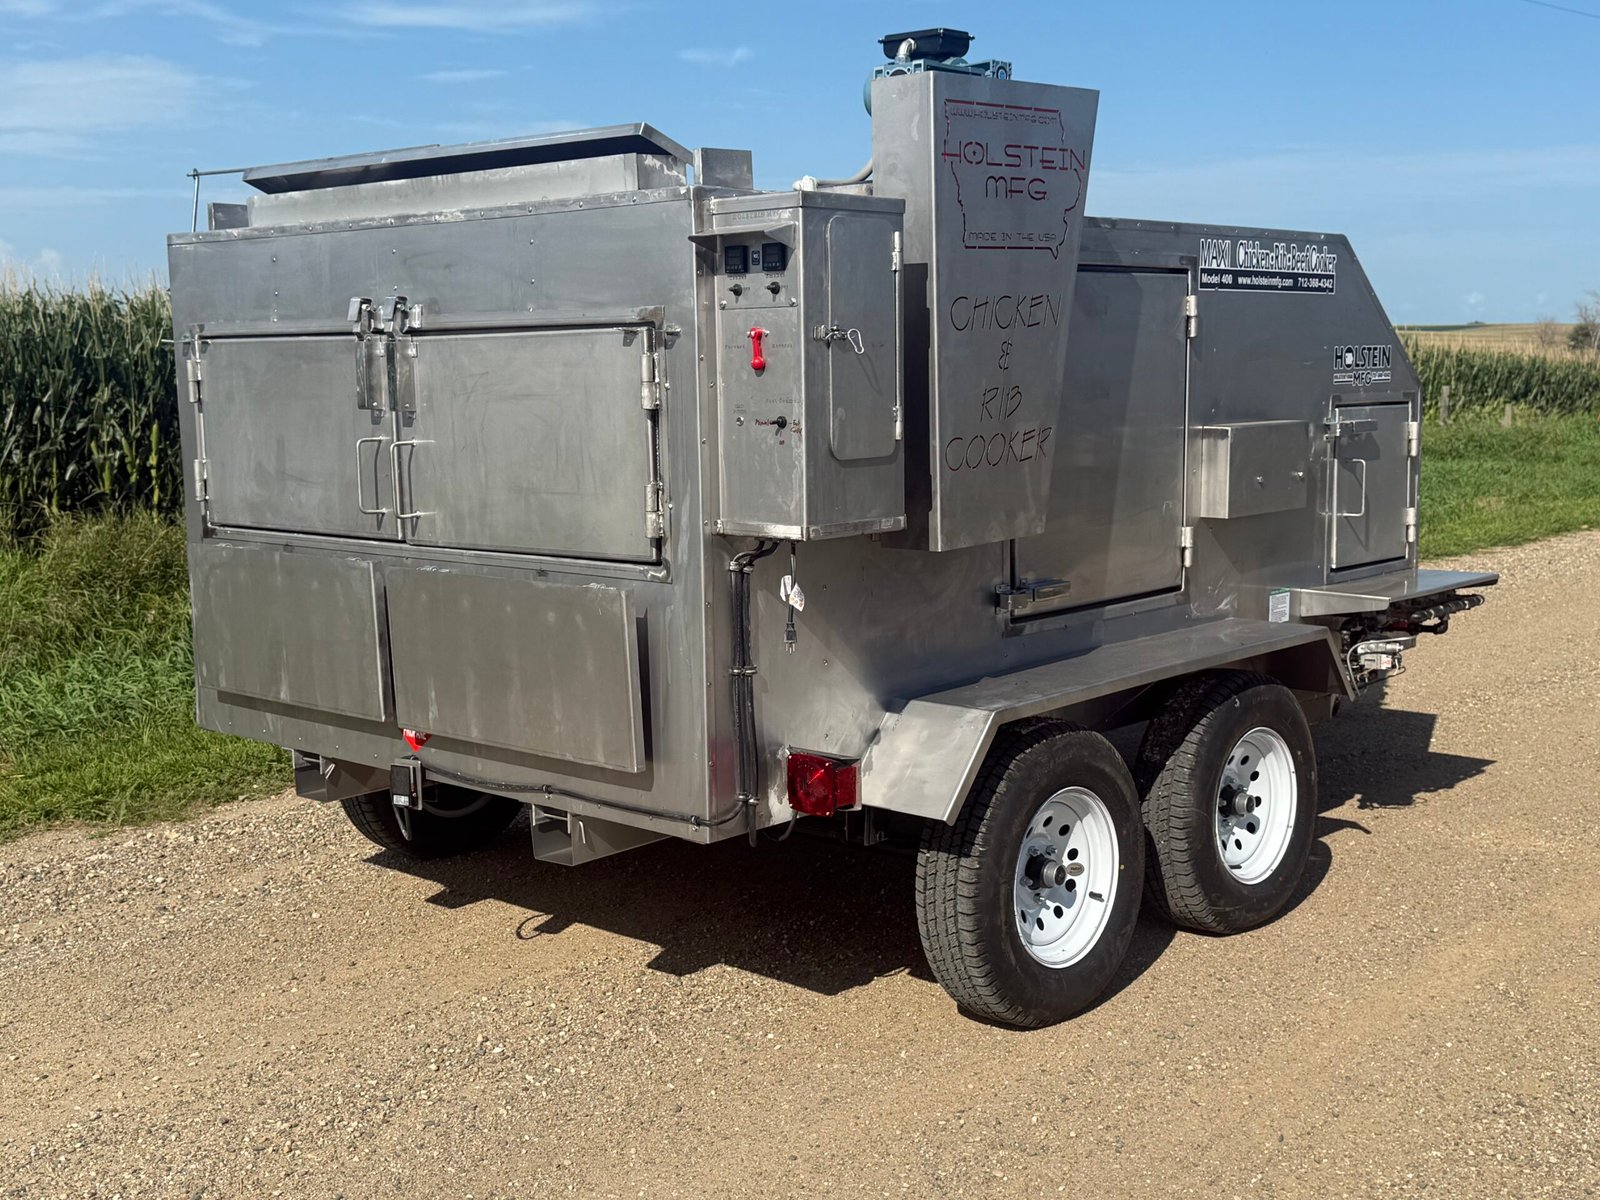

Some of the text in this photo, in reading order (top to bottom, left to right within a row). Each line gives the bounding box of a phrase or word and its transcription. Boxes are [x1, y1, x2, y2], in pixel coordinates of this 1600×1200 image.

[942, 140, 1086, 171] HOLSTEIN
[985, 175, 1047, 201] MFG
[968, 232, 1057, 242] MADE IN THE USA
[1200, 239, 1232, 268] MAXI
[1201, 273, 1221, 284] Model
[1221, 274, 1233, 284] 400
[1237, 275, 1294, 288] www.holsteinmfg.com
[950, 294, 1062, 332] CHICKEN
[1334, 345, 1391, 370] HOLSTEIN
[1352, 371, 1373, 386] MFG
[980, 385, 1023, 422] RIB
[944, 427, 1053, 472] COOKER
